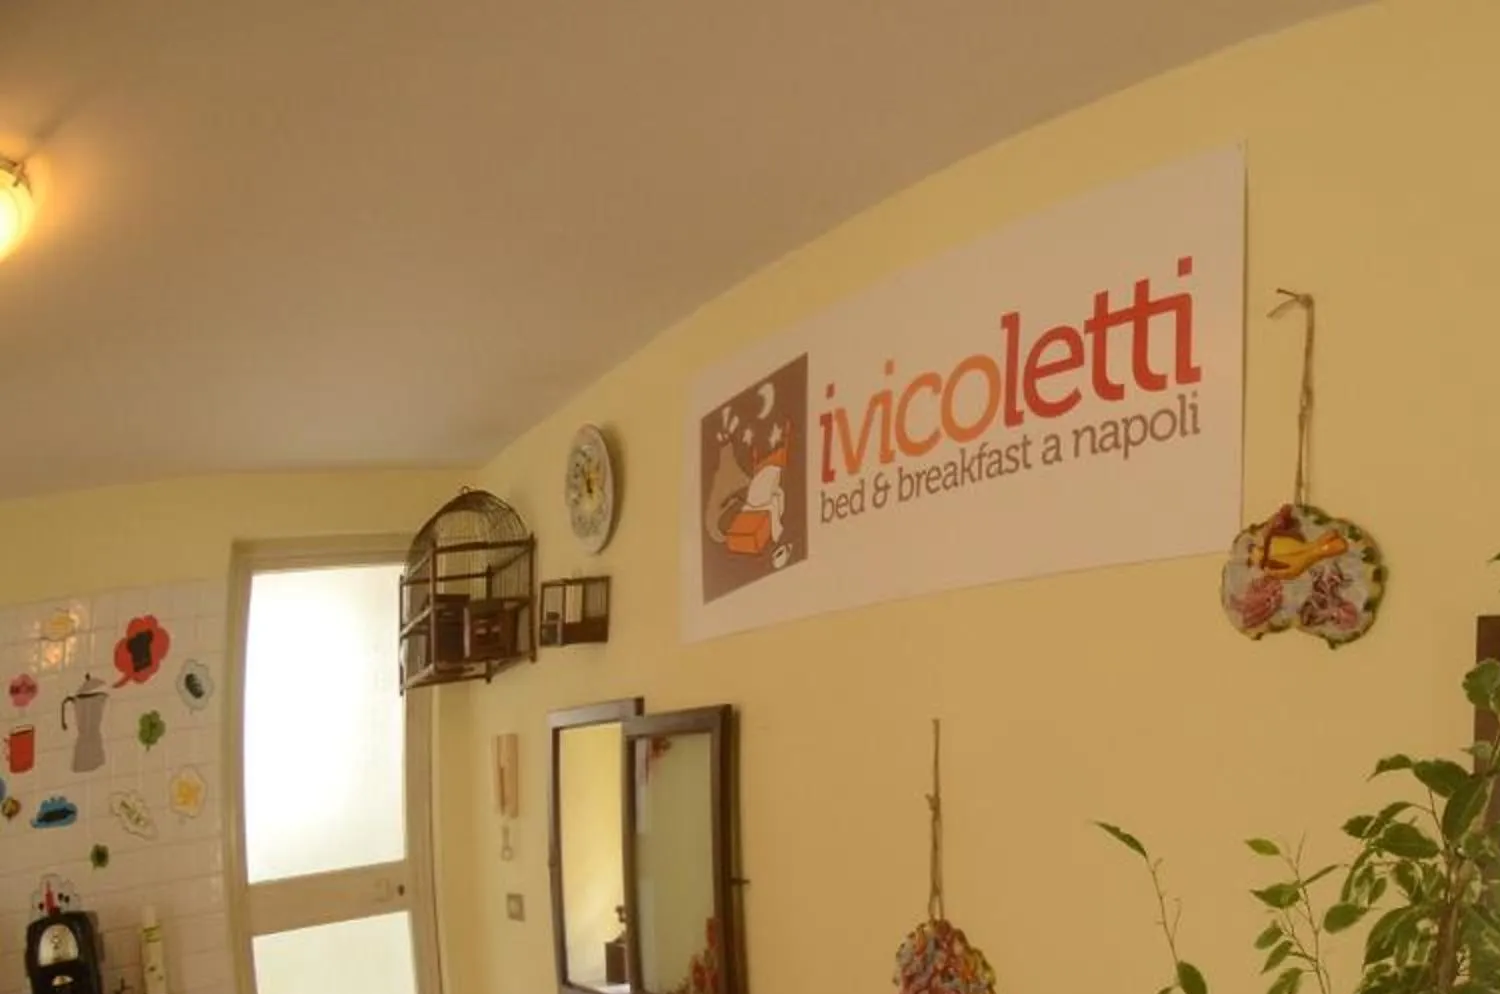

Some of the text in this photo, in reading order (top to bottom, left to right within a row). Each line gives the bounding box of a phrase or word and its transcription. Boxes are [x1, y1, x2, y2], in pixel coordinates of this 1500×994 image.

[820, 256, 1202, 484] ivicoletti
[820, 391, 1202, 523] bed & breakfast a napoli
